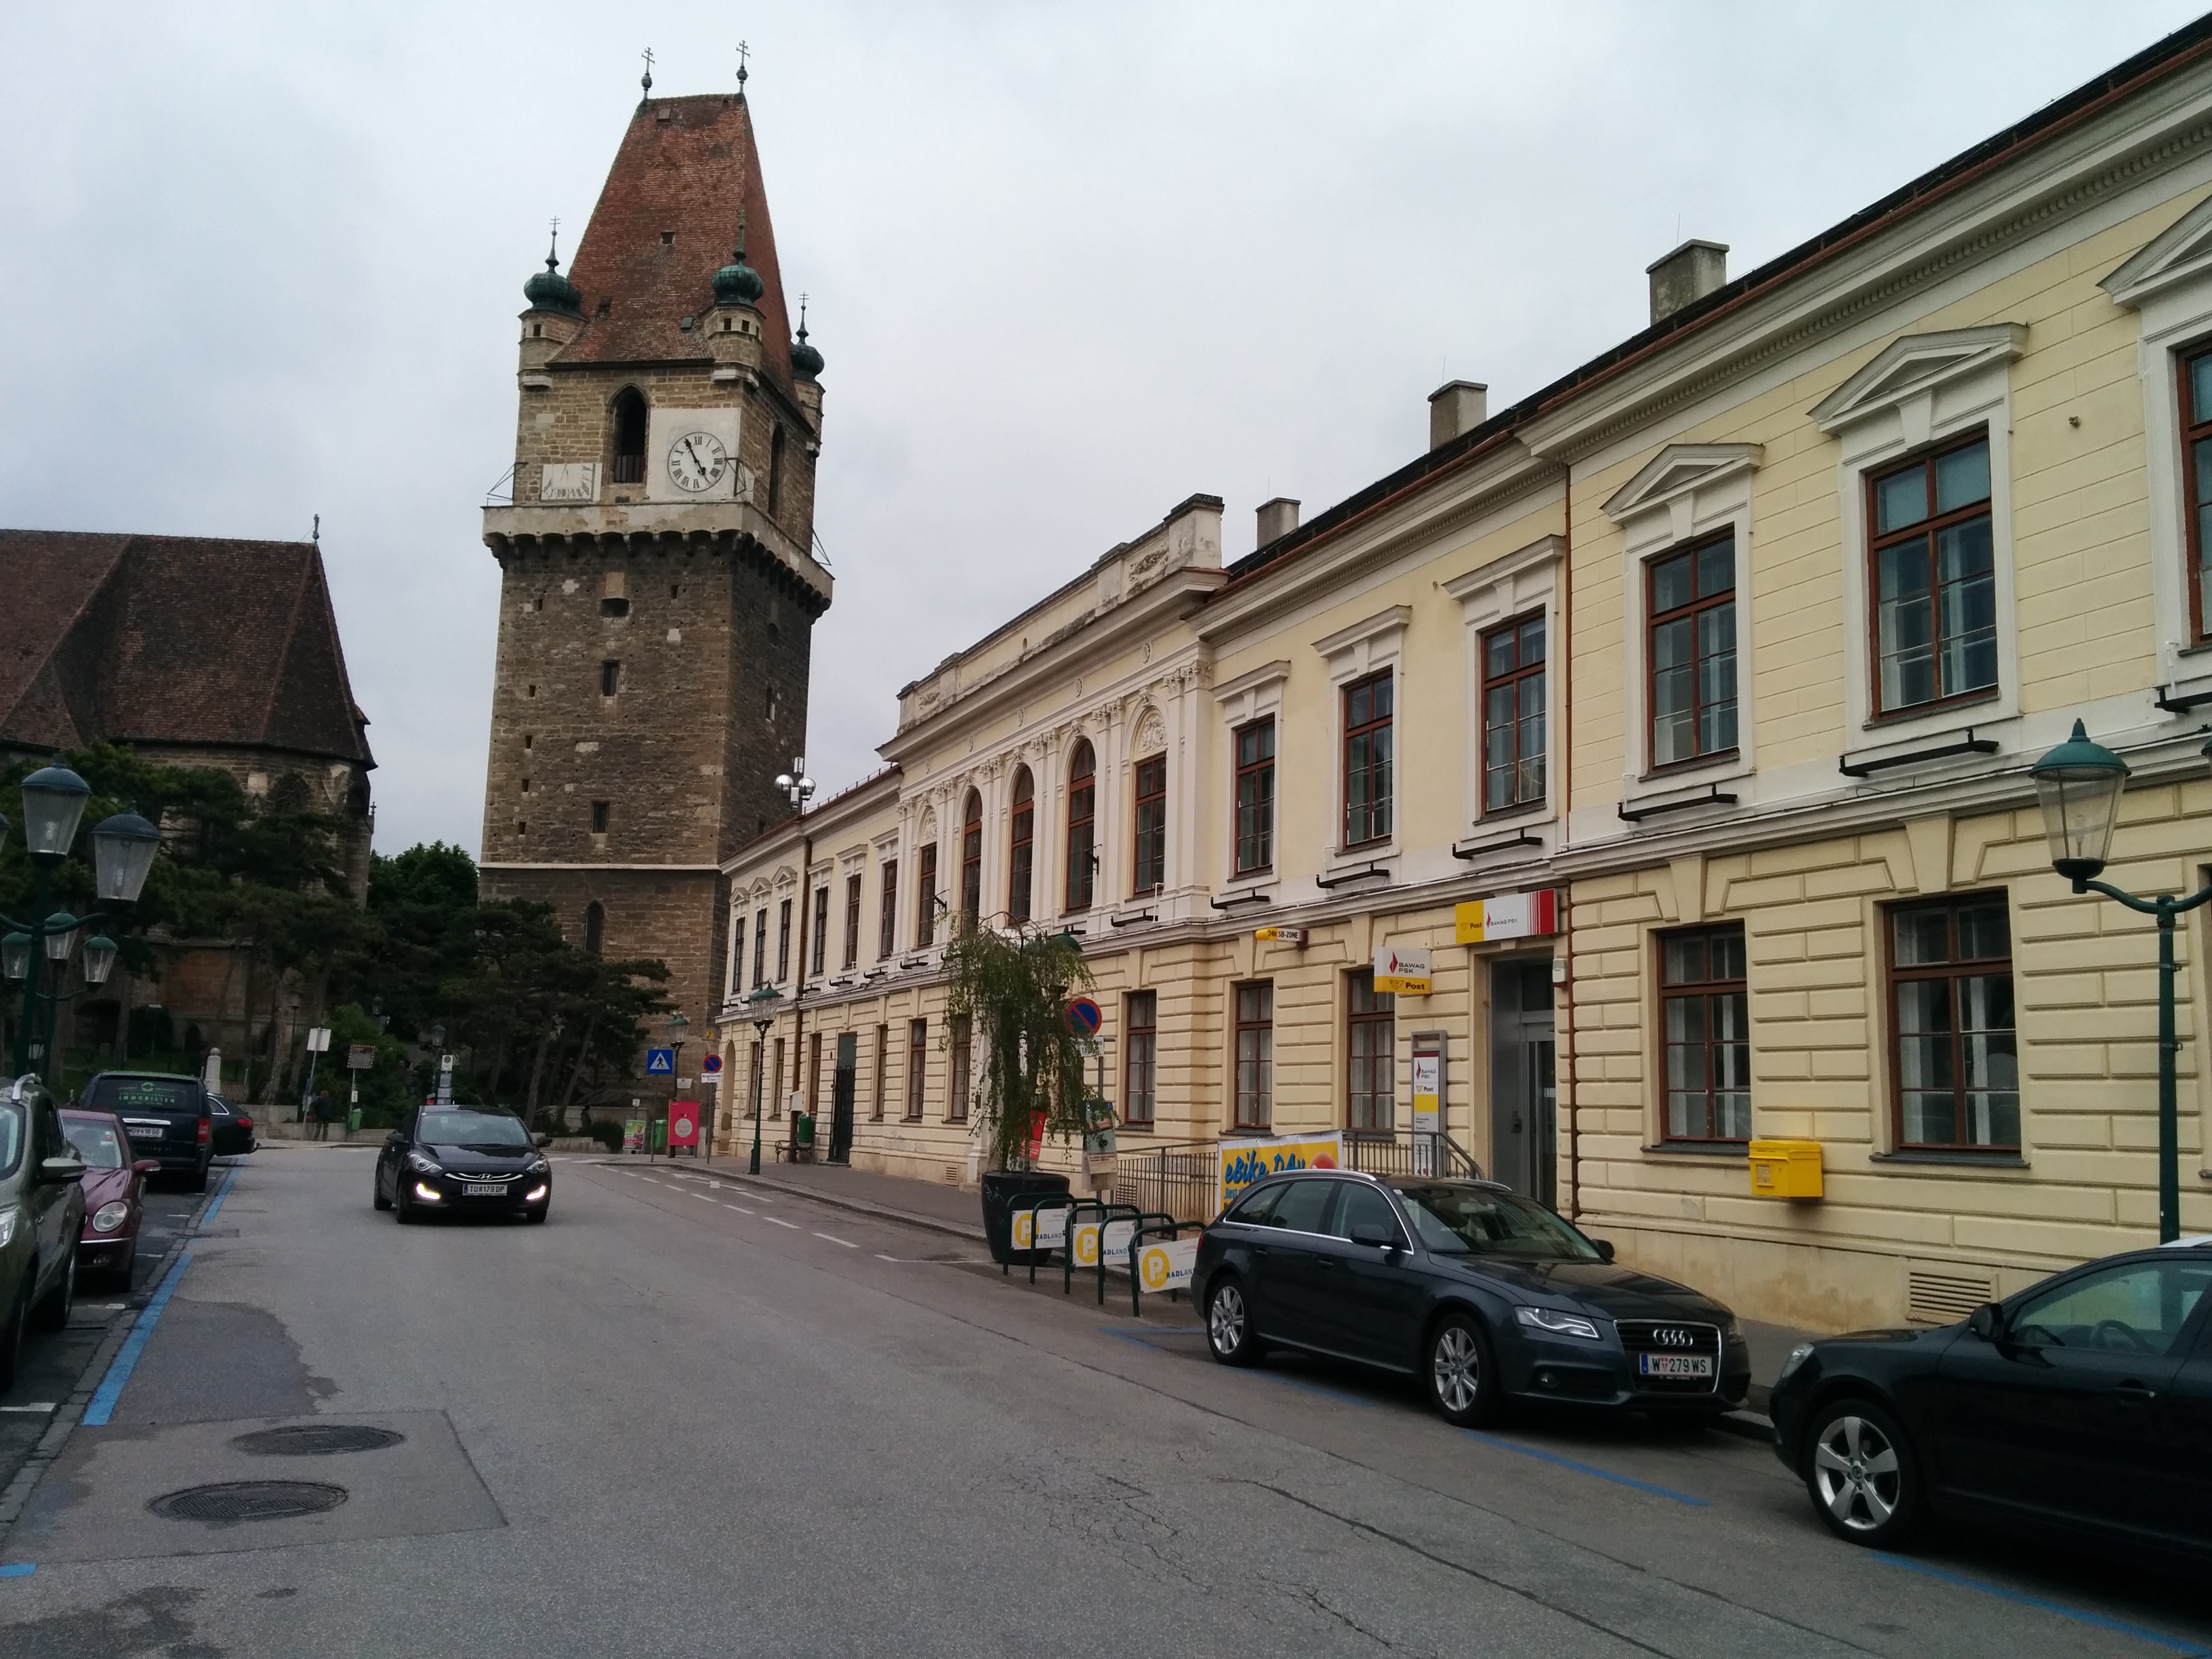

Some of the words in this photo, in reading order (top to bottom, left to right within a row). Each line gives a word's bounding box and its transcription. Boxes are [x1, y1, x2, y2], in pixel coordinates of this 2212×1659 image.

[1277, 930, 1298, 939] SB-ZONE
[1405, 982, 1425, 990] Post
[119, 1095, 175, 1103] IMMOBILIEN
[1225, 1149, 1269, 1183] eBike
[1082, 1234, 1097, 1257] P
[1103, 1248, 1128, 1256] ADLAND
[1148, 1256, 1164, 1282] P
[1166, 1268, 1193, 1279] RADLAN
[1652, 1357, 1660, 1372] W
[1668, 1358, 1690, 1373] 279
[1692, 1359, 1706, 1374] WS
